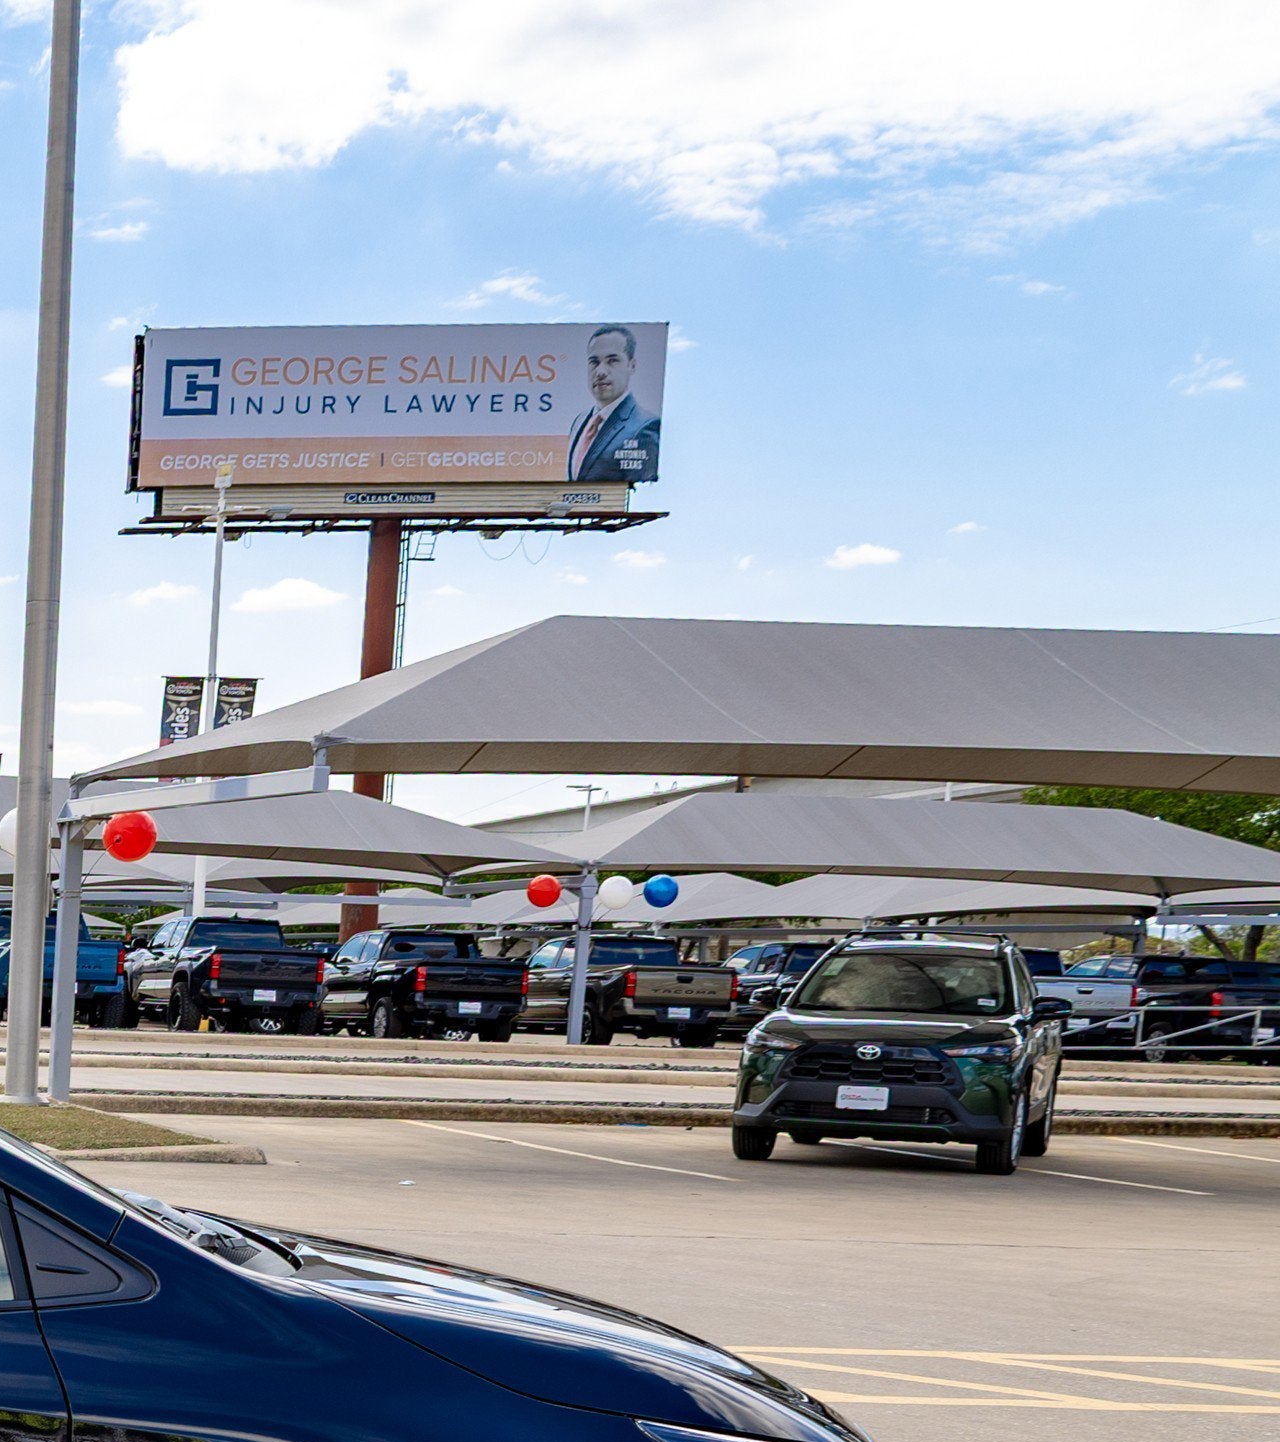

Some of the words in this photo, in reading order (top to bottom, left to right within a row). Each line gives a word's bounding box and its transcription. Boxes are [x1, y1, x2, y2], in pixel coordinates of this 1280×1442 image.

[230, 356, 388, 385] GEORGE
[398, 354, 557, 384] SALINAS
[230, 395, 361, 415] INJURY
[383, 393, 553, 413] LAWYERS
[160, 453, 239, 470] GEORGE
[242, 453, 290, 469] GETS
[293, 452, 370, 468] JUSTICE
[390, 451, 554, 467] GETGEORGE.COM
[619, 460, 643, 470] TEXAS
[170, 707, 190, 740] icles
